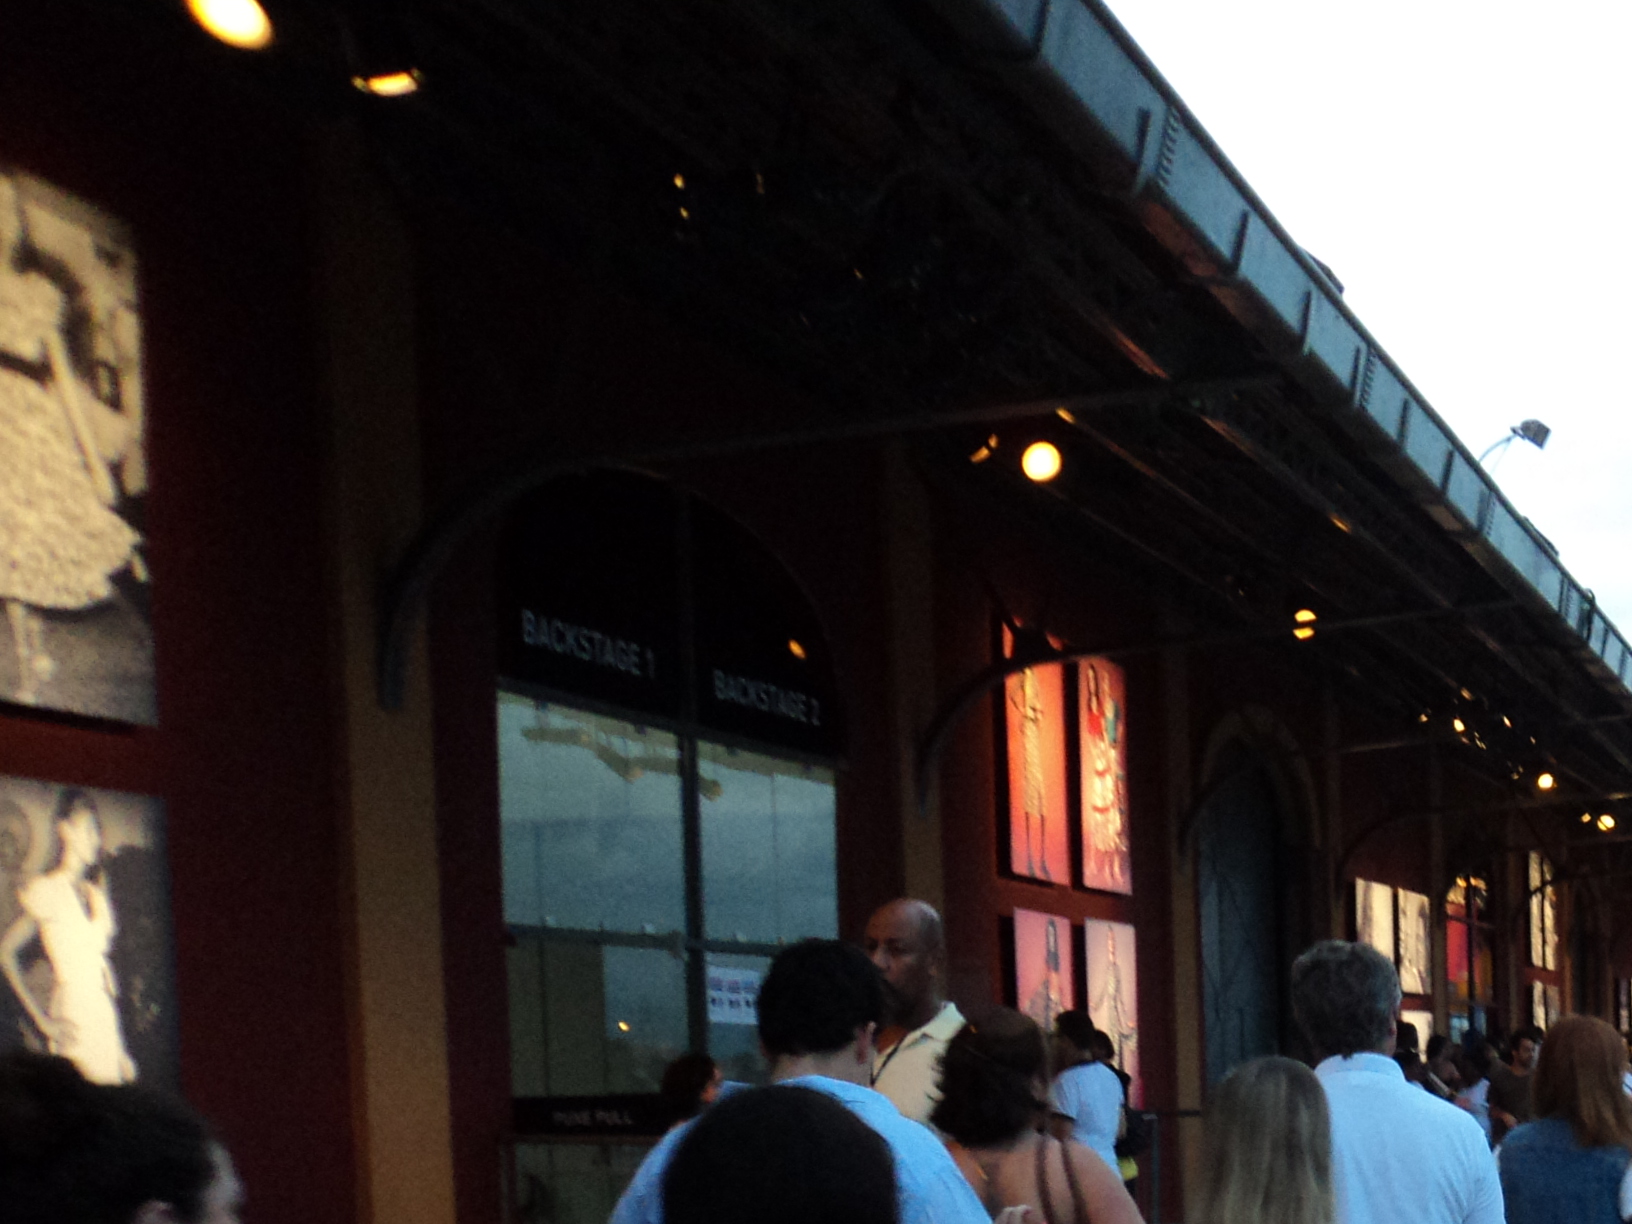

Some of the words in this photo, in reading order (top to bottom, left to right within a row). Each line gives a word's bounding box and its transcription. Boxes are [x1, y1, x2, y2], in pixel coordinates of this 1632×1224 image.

[521, 607, 640, 678] BACKSTAGE
[645, 648, 656, 681] 1
[712, 666, 807, 725] BACKSTAGE
[808, 696, 821, 728] 2
